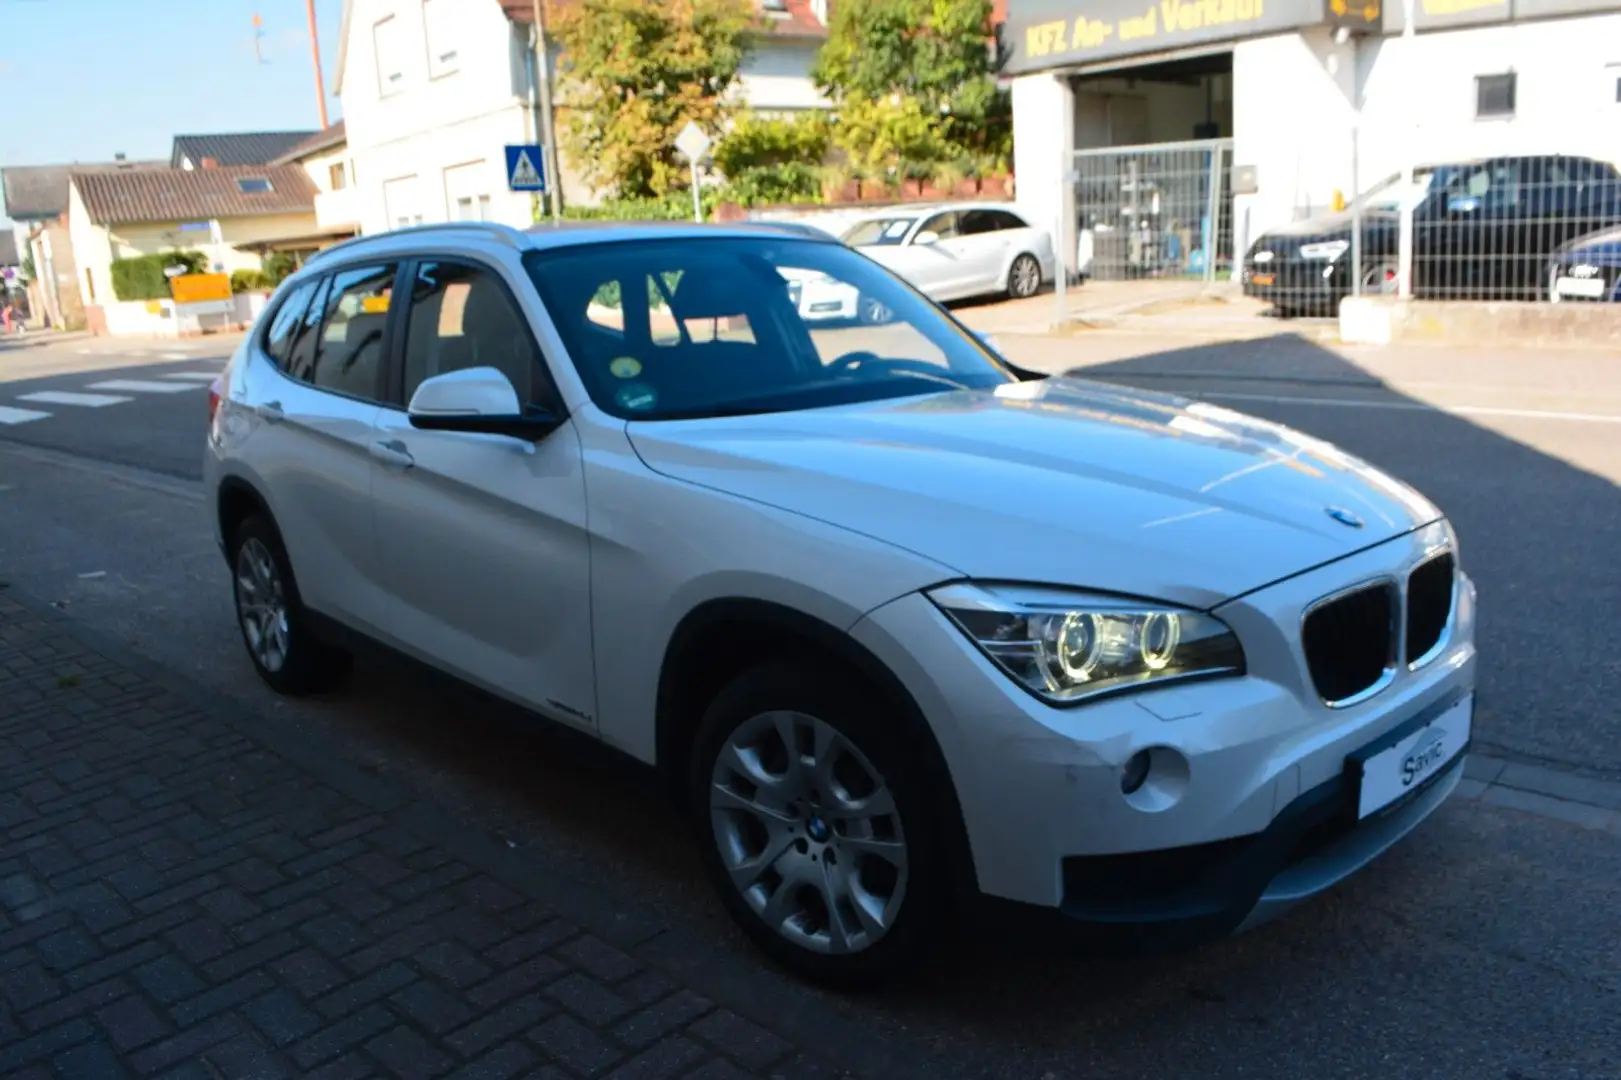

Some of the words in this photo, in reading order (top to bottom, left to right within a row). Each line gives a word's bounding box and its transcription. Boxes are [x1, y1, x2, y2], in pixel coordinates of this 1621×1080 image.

[1026, 20, 1067, 58] KFZ
[1072, 16, 1113, 49] An-
[1118, 6, 1157, 41] und
